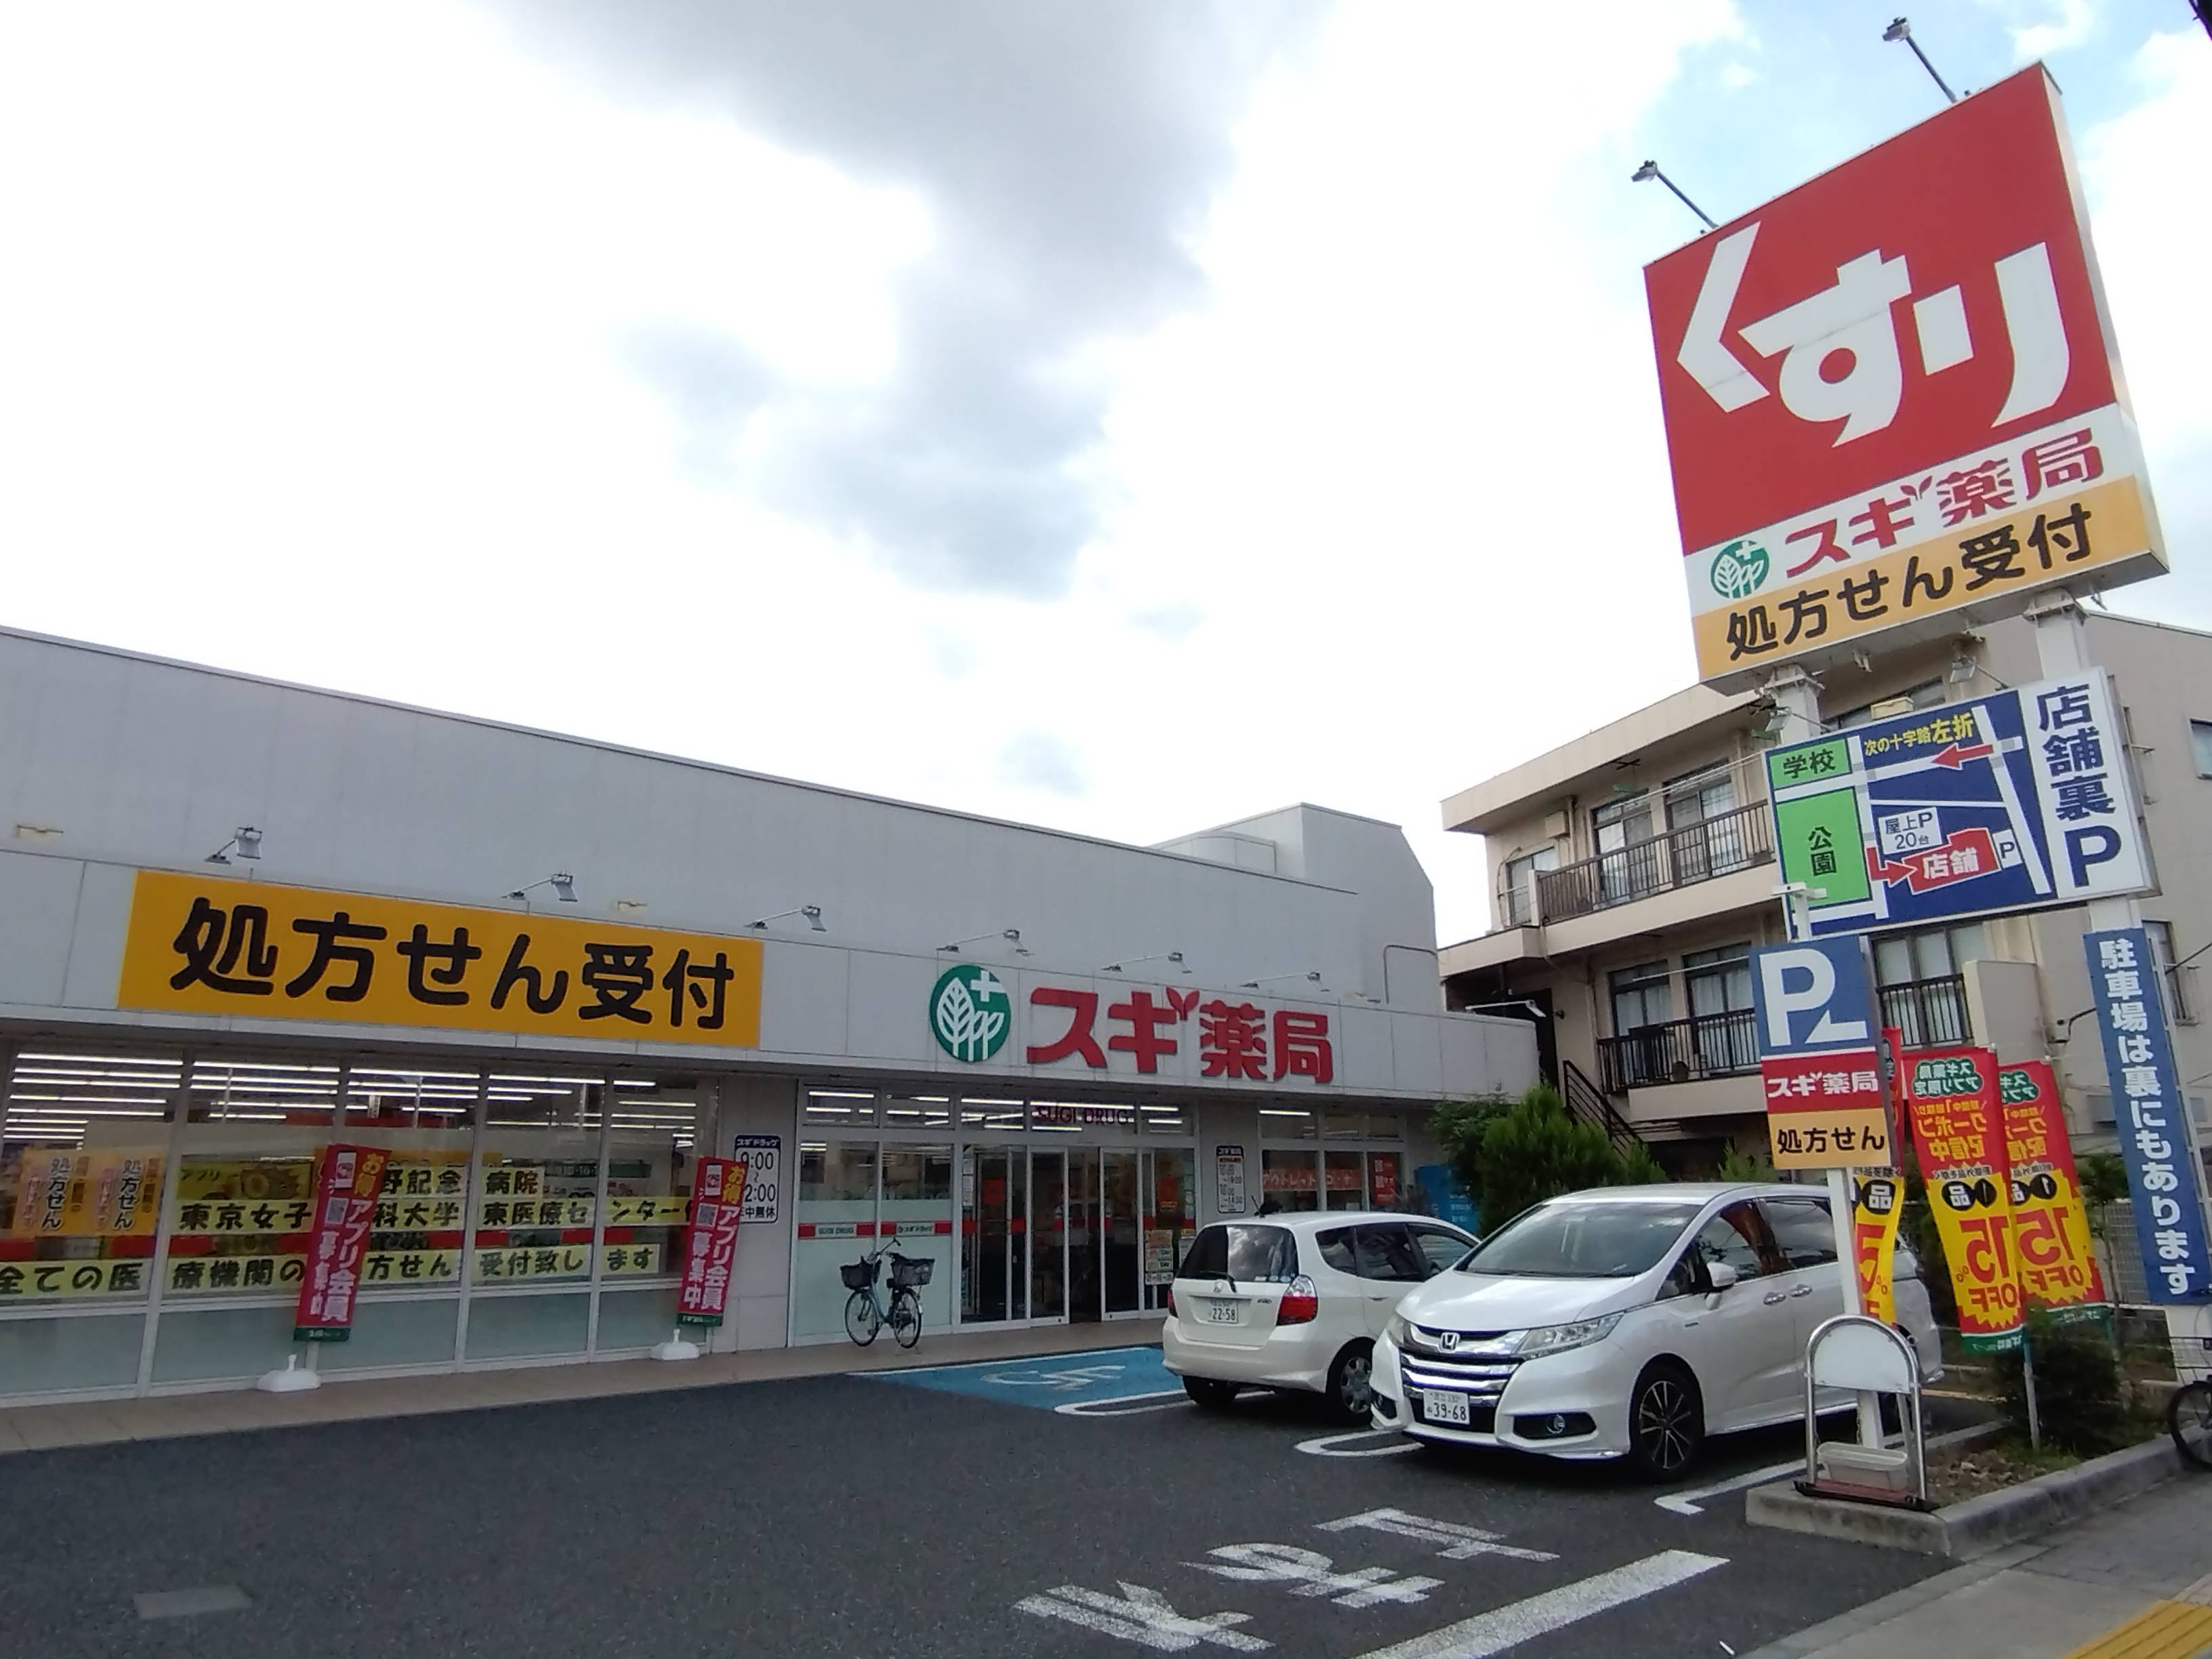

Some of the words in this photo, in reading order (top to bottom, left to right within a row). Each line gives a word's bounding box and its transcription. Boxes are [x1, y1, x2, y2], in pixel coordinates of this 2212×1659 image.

[1677, 221, 2070, 447] くすり
[1785, 428, 2104, 578] スギ薬局
[1726, 504, 2091, 661] 処方せん受付
[1865, 713, 1974, 756] 次の十字路左折
[1783, 749, 1835, 778] 学校
[1885, 811, 1932, 835] 屋上P
[1895, 832, 1930, 850] 20台
[1808, 826, 1837, 876] 公園
[1922, 847, 1980, 879] 店舗
[2001, 840, 2016, 859] P
[171, 897, 735, 1029] 処方せん受付
[1027, 986, 1333, 1083] スギ薬局
[1767, 1071, 1879, 1097] スギ薬局
[1777, 1126, 1885, 1154] 処方せん
[2100, 939, 2195, 1294] 駐車場は裏にもあります
[42, 1158, 70, 1231] 処方せん
[114, 1160, 142, 1231] 処方せん
